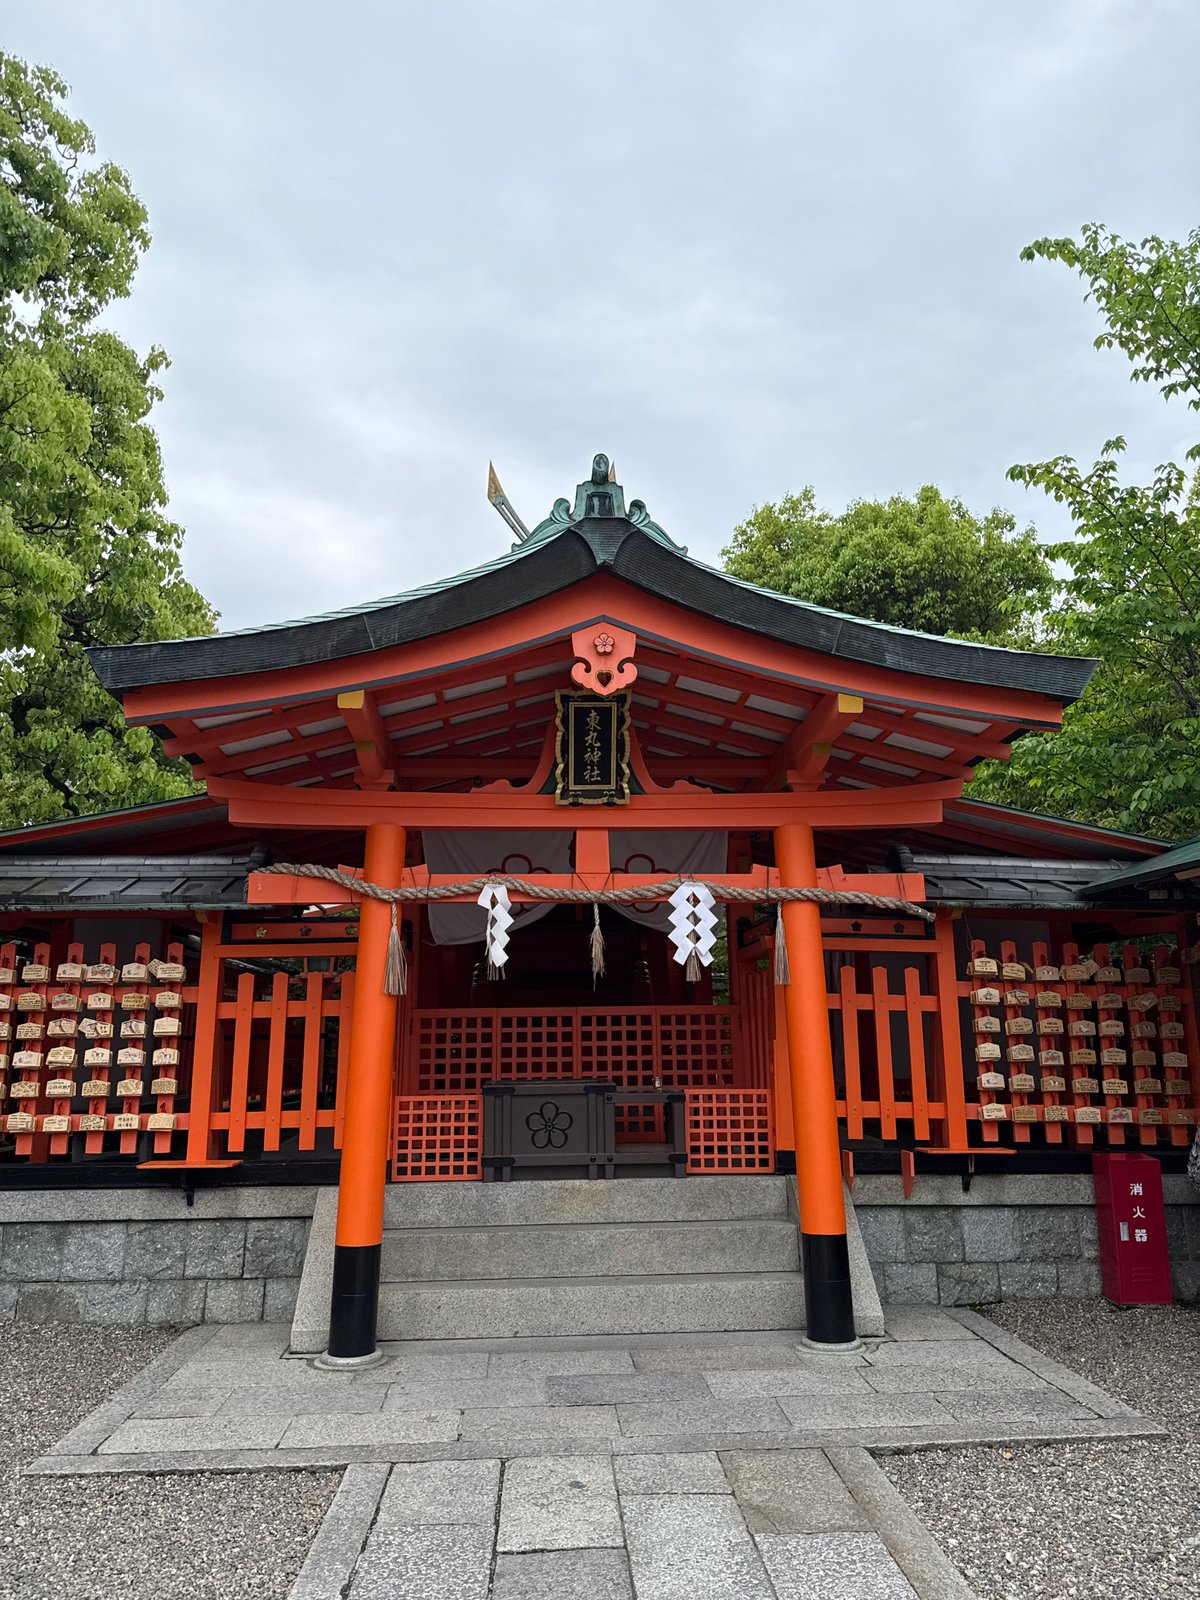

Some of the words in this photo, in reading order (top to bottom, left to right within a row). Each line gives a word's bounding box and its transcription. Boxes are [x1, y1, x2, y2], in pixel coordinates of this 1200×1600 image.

[584, 709, 602, 782] 東丸神社
[1129, 1183, 1148, 1242] 消火器
